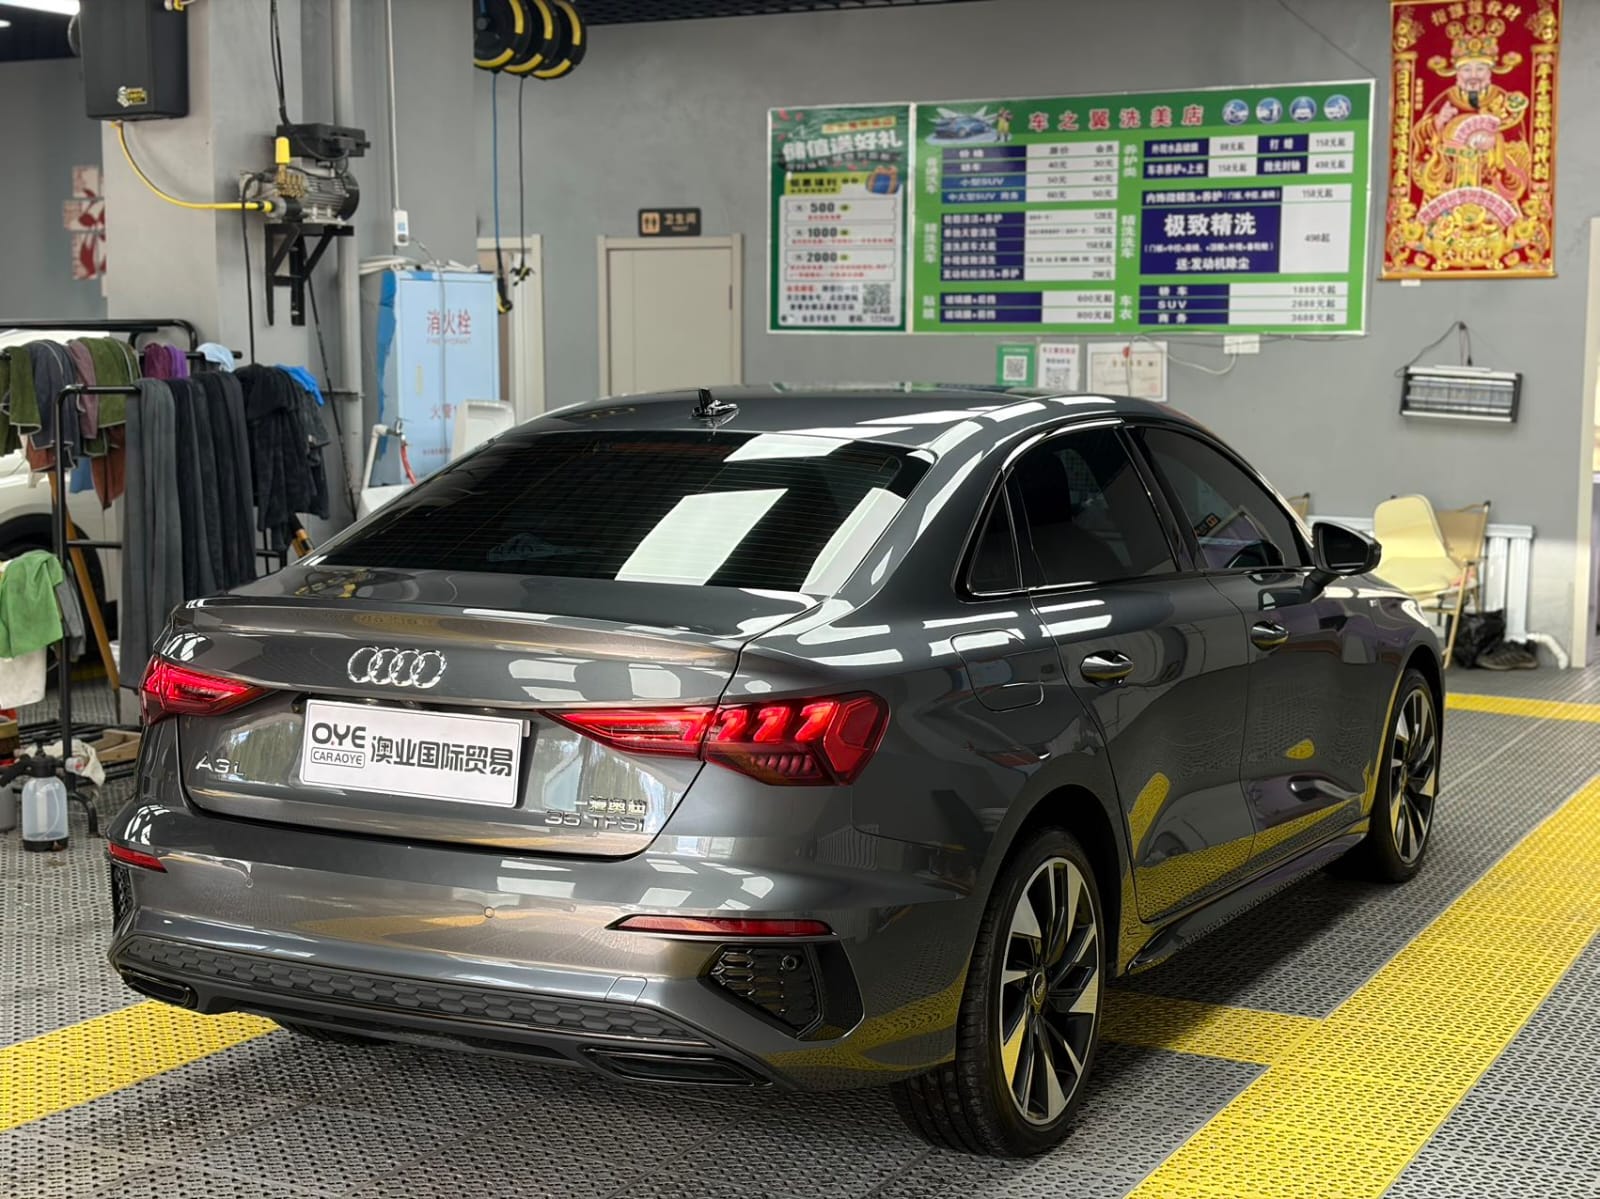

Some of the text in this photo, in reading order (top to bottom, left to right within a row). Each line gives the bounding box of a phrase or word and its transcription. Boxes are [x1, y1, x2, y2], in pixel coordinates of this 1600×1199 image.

[1029, 104, 1204, 131] 车之翼洗美店
[810, 203, 835, 213] 500
[664, 213, 697, 225] 卫生间
[1164, 211, 1256, 237] 极致精洗
[808, 227, 838, 238] 1000
[806, 252, 838, 262] 2000
[1158, 300, 1187, 309] SUV
[426, 308, 473, 336] 消火栓
[371, 735, 514, 777] 澳业国际贸易
[544, 809, 645, 832] 35 TFSI
